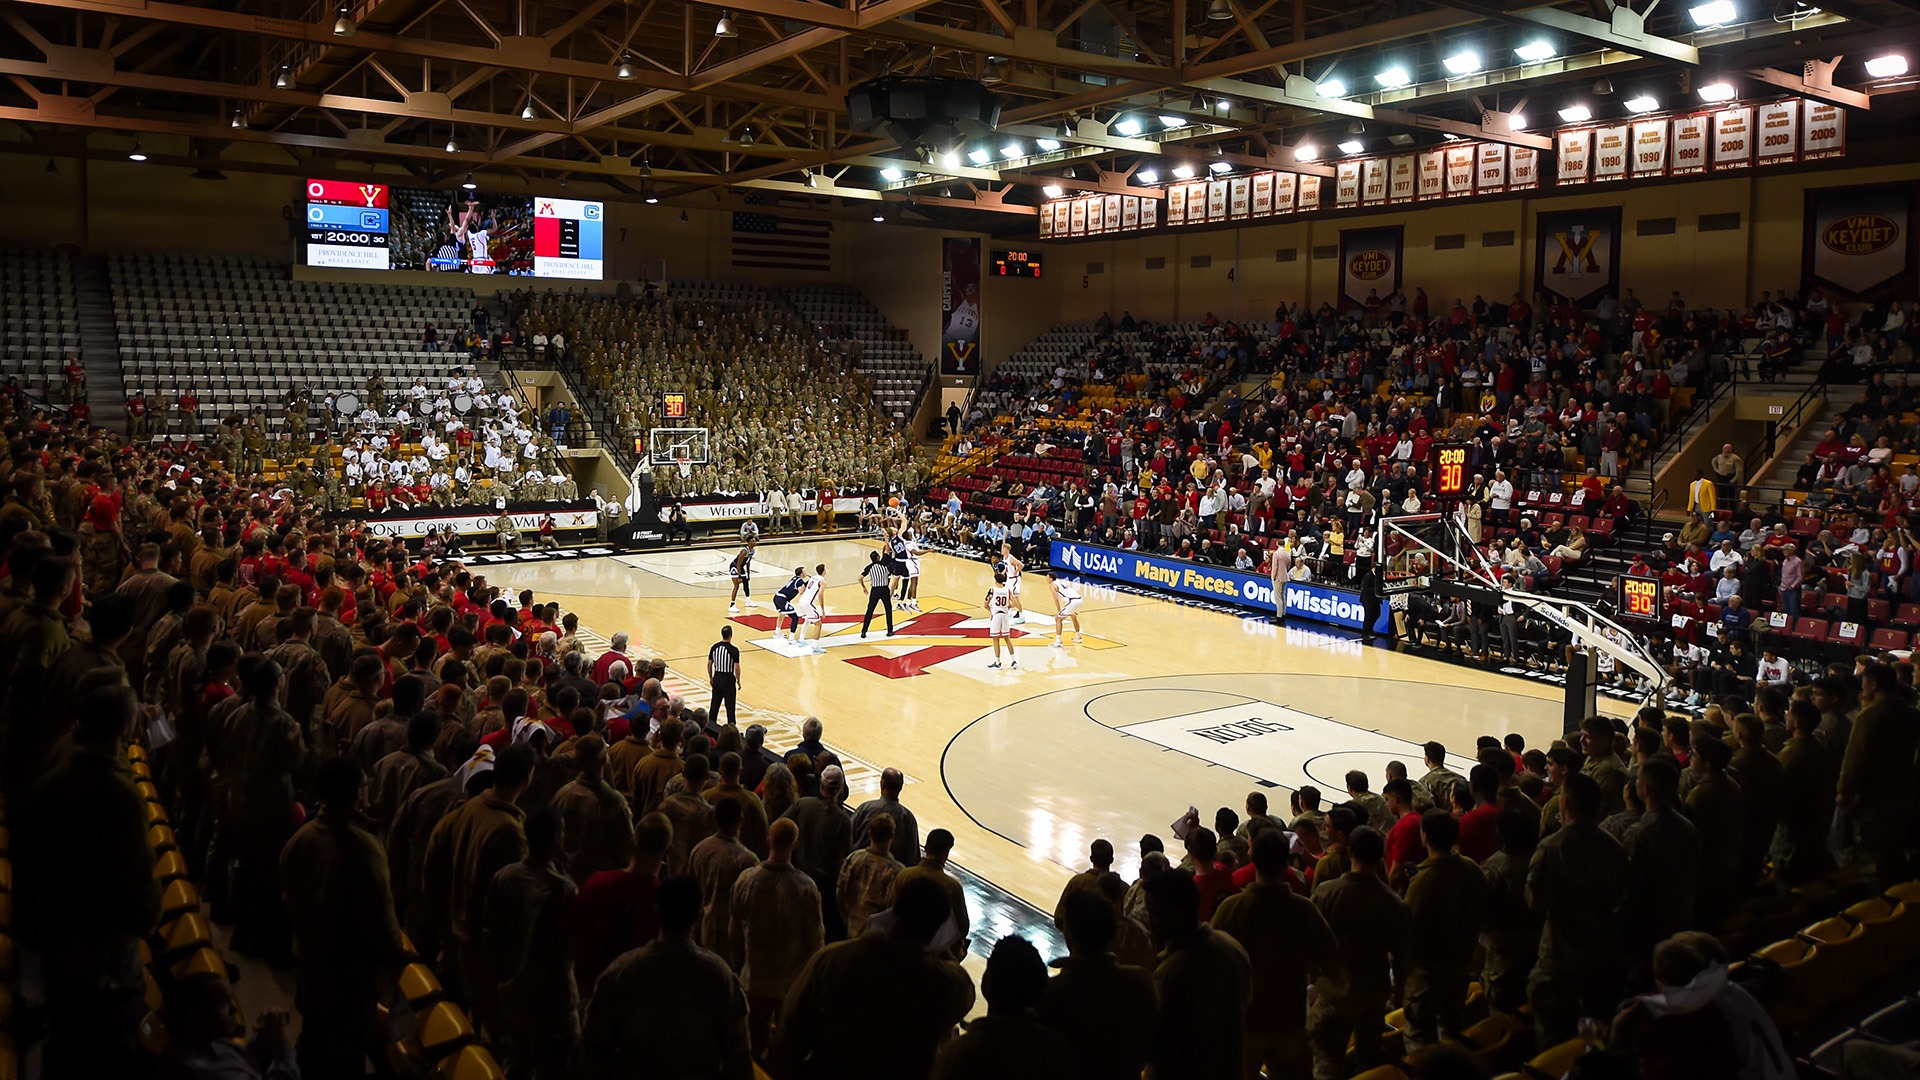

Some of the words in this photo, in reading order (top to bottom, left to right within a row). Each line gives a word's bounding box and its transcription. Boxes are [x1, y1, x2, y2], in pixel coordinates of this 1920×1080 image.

[1765, 120, 1789, 128] HOLMES
[1811, 128, 1836, 140] 2009
[1721, 140, 1743, 152] 2008
[1765, 134, 1789, 147] 2009
[1639, 152, 1659, 163] 1990
[1679, 148, 1699, 159] 1992
[1564, 160, 1583, 171] 1986
[1601, 156, 1620, 168] 1990
[1483, 168, 1499, 178] 1979
[1515, 166, 1531, 177] 1981
[1423, 178, 1438, 188] 1978
[1452, 174, 1468, 184] 1978
[1341, 187, 1354, 196] 1976
[1368, 184, 1382, 194] 1977
[1395, 181, 1409, 191] 1977
[1847, 217, 1875, 228] VMI
[327, 232, 368, 243] 20:00
[619, 229, 627, 241] 7
[1829, 227, 1892, 244] KEYDET
[1846, 243, 1872, 252] CLUB
[319, 250, 361, 258] PROVIDENCE
[1362, 252, 1378, 260] VMI
[1353, 260, 1387, 271] KEYDET
[1000, 266, 1006, 275] 0
[1034, 268, 1040, 277] 0
[1227, 268, 1234, 281] 4
[1083, 276, 1088, 288] 5
[943, 271, 951, 311] CARTER
[959, 316, 972, 328] 13
[667, 403, 681, 415] 30
[1440, 449, 1465, 464] 20:00
[1441, 465, 1461, 491] 30
[710, 507, 755, 516] WHOLE
[373, 524, 403, 535] ONE
[477, 518, 496, 530] ON
[515, 517, 540, 527] VMI
[1135, 560, 1181, 587] Many
[1183, 569, 1239, 596] Faces.
[1286, 588, 1365, 621] Mission
[1625, 580, 1656, 596] 20:00
[995, 596, 1007, 606] 30
[1631, 595, 1650, 612] 30
[1540, 607, 1570, 628] Schelde
